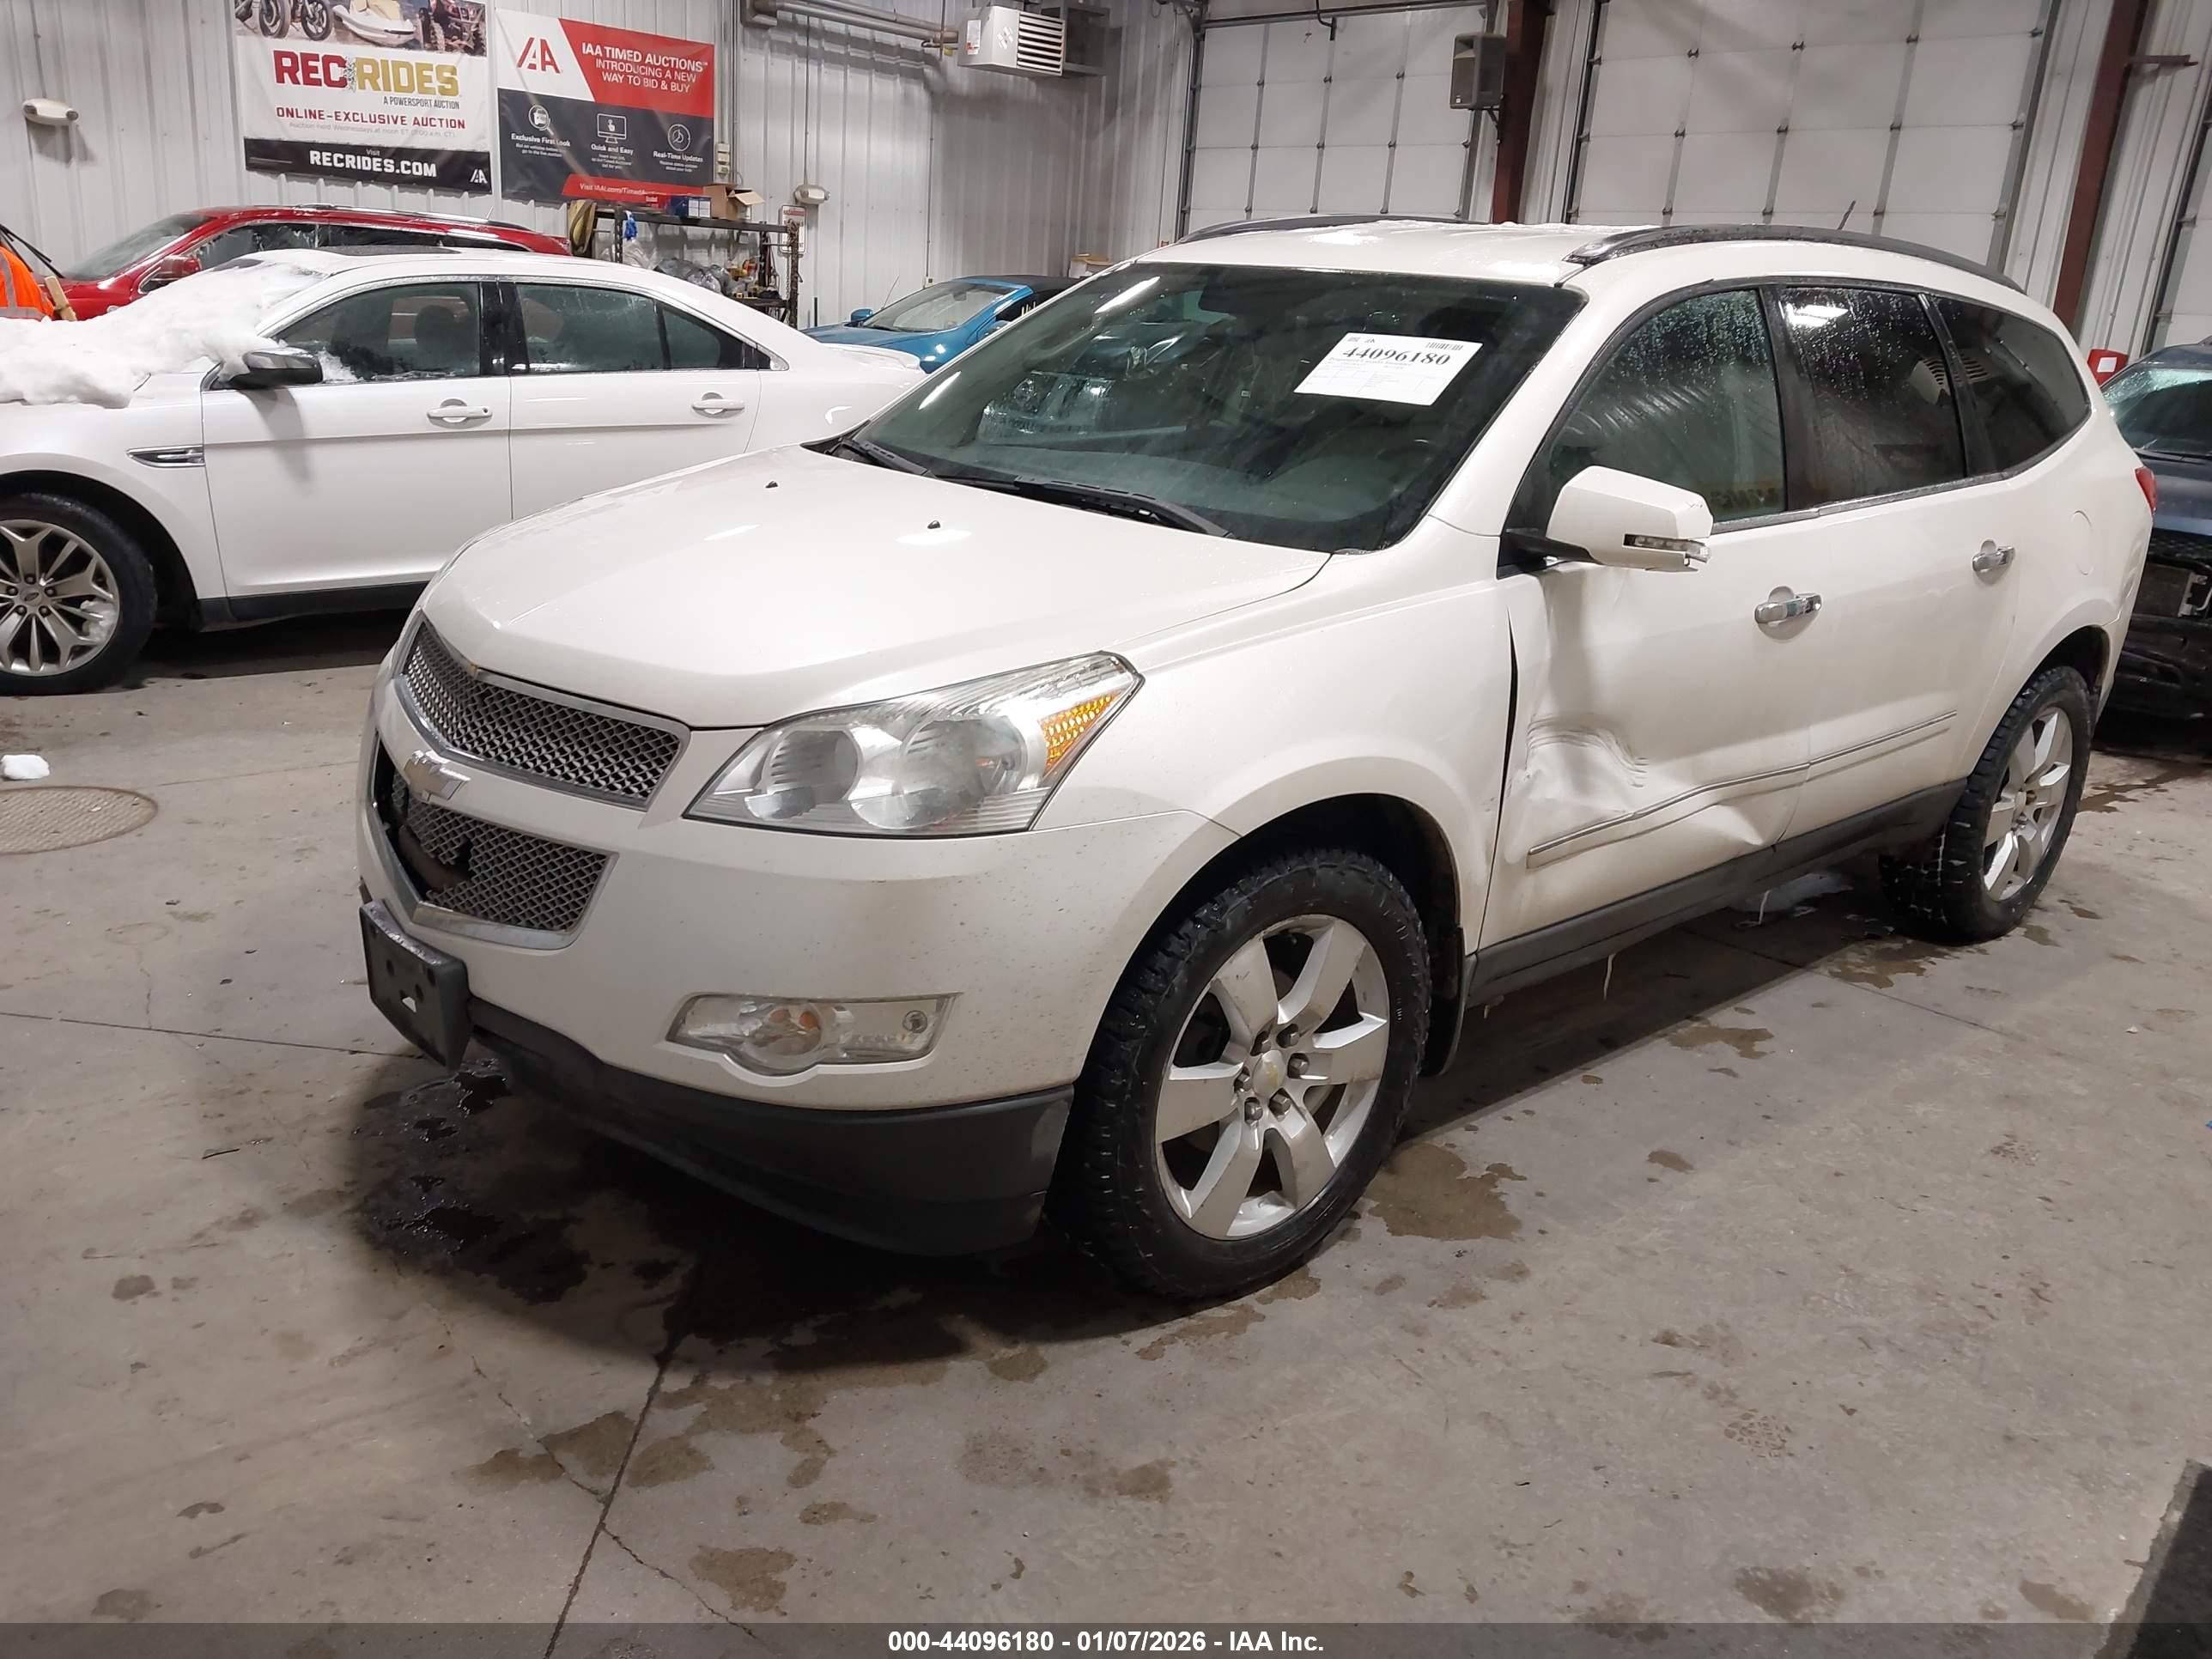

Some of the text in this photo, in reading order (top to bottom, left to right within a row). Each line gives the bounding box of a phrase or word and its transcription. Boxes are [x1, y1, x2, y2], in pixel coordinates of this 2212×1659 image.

[582, 42, 602, 57] IAA
[604, 46, 642, 63] TIMED
[273, 50, 459, 97] REC RIDES
[596, 58, 696, 82] INTRODUCING A NEW
[602, 71, 690, 93] WAY TO BID & BUY
[383, 96, 459, 110] A POWERSPORT AUCTION
[276, 106, 465, 130] ONLINE-EXCLUSIVE AUCTION
[511, 132, 541, 143] Exclusive
[620, 146, 634, 155] Easy
[653, 150, 681, 160] Real-Time
[309, 149, 437, 178] RECRIDES.COM
[1342, 347, 1449, 367] 44096180
